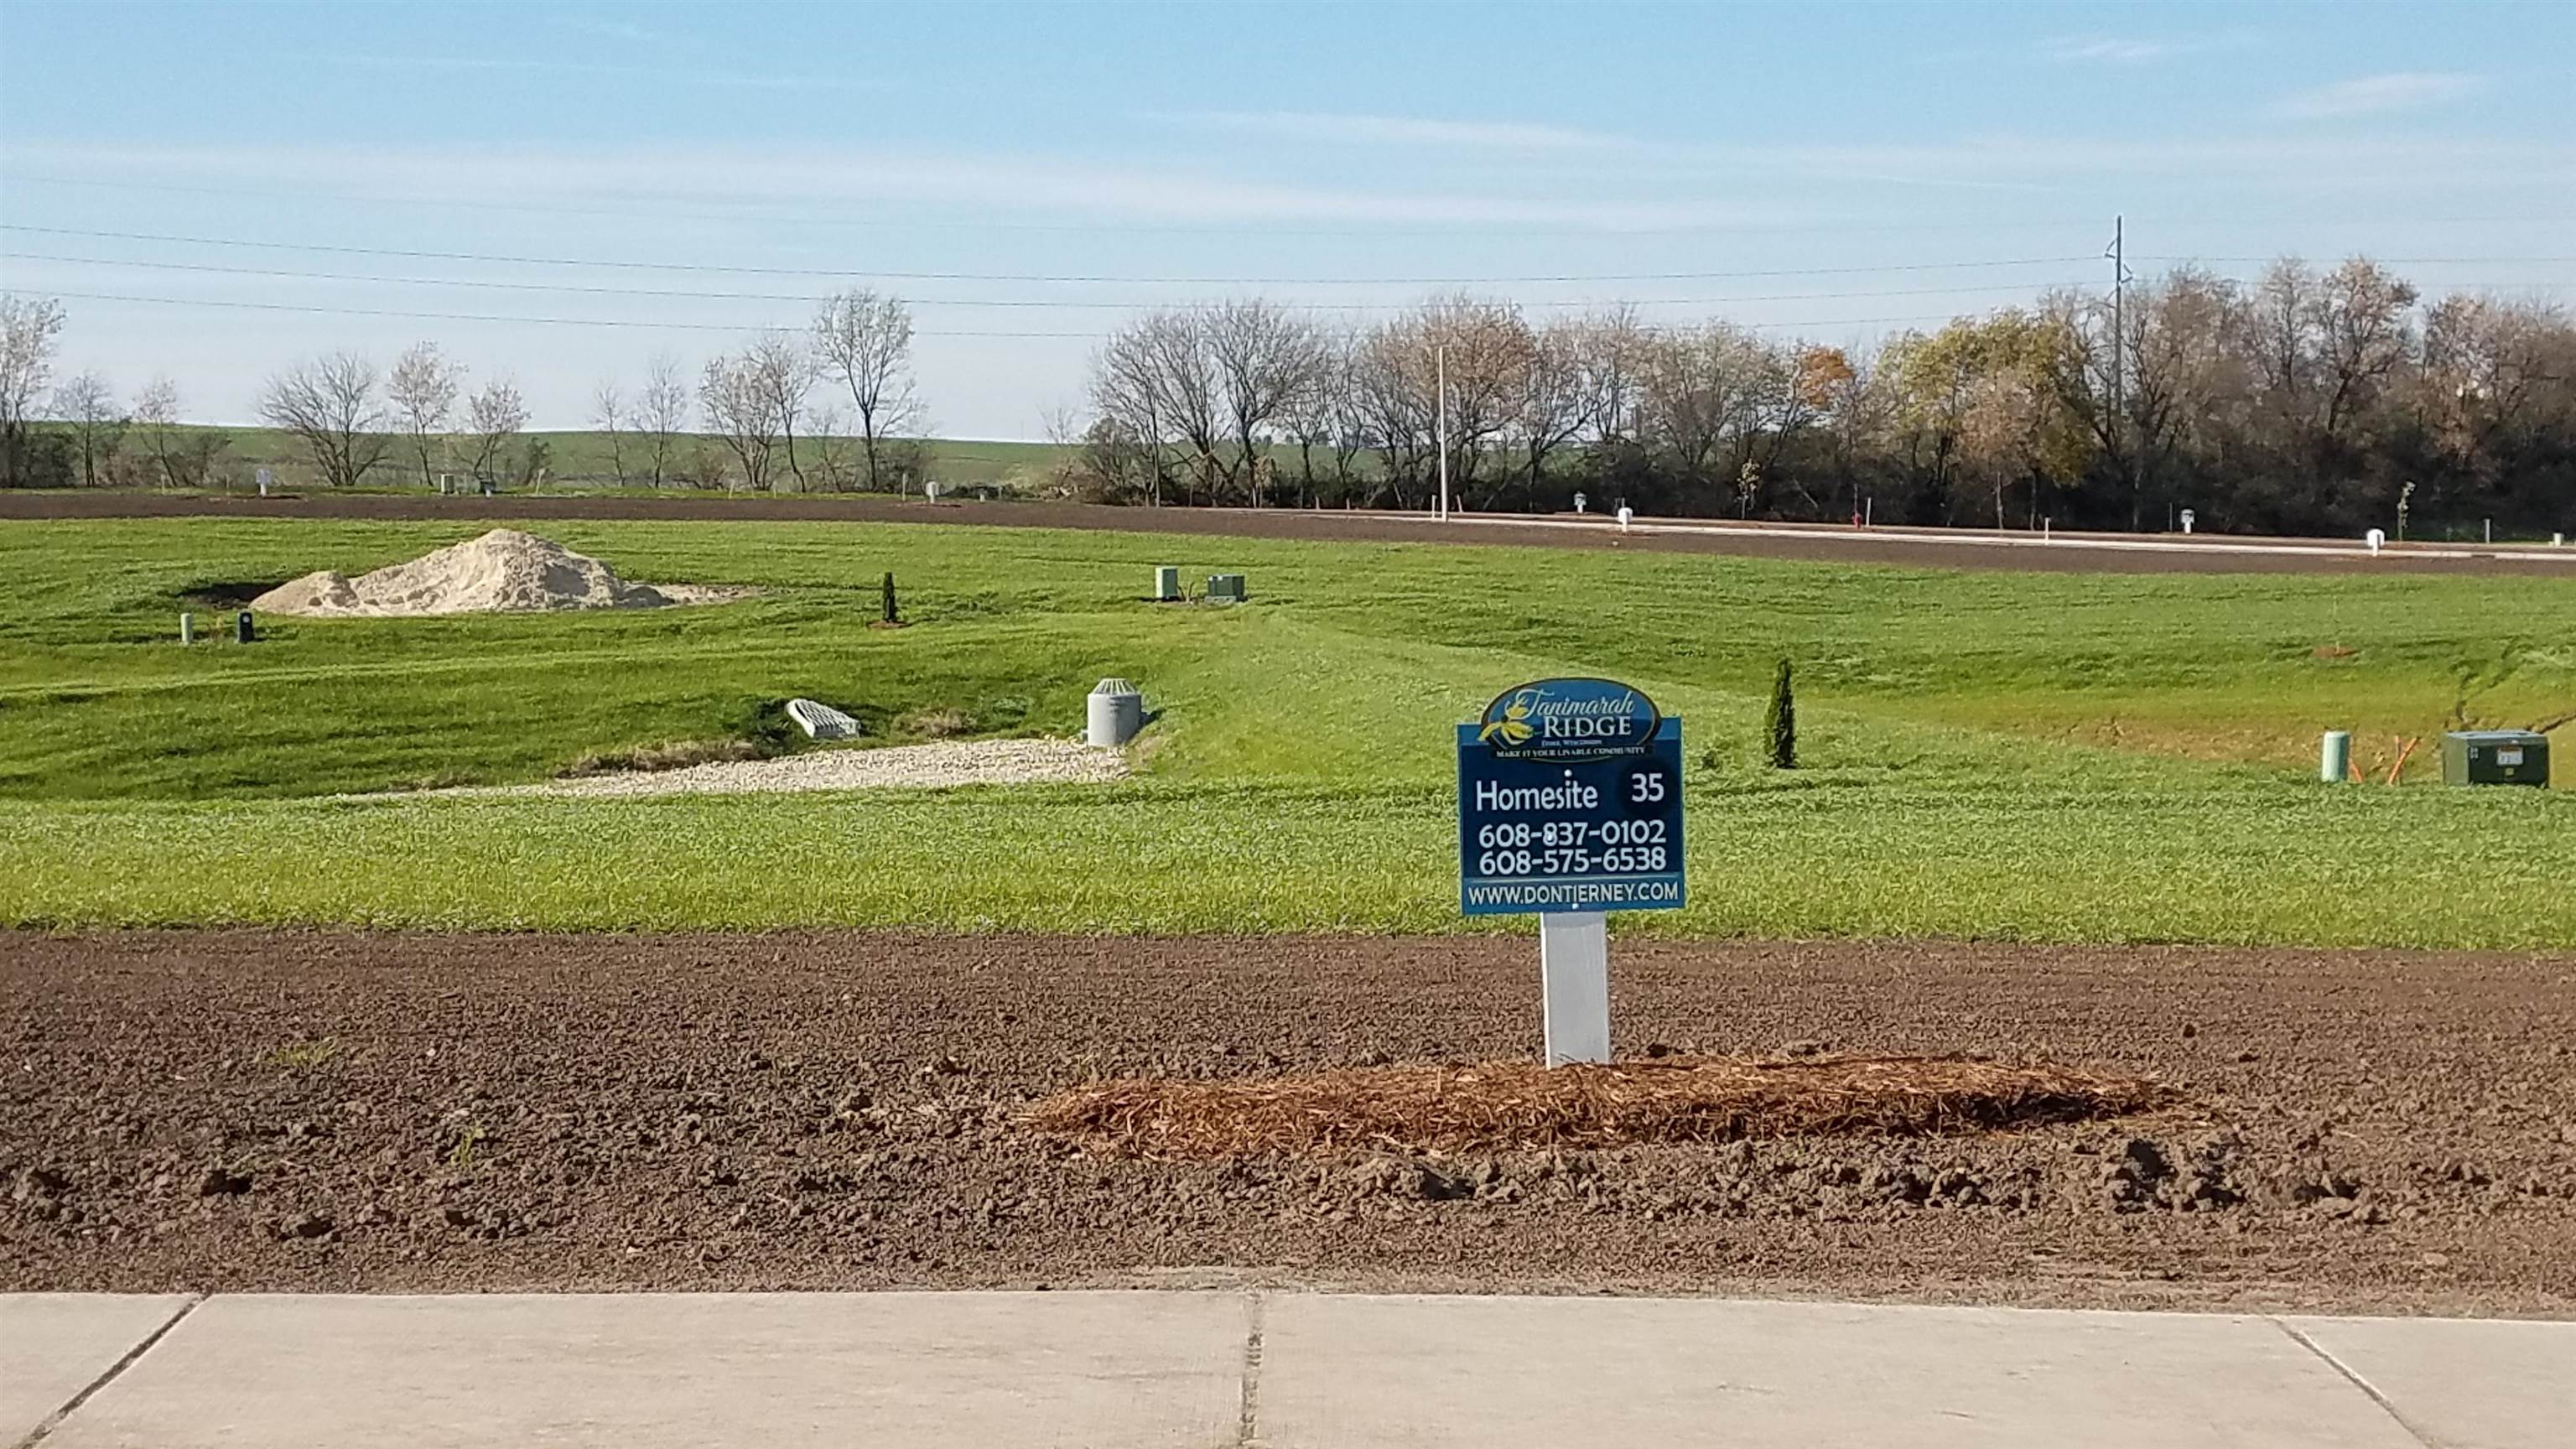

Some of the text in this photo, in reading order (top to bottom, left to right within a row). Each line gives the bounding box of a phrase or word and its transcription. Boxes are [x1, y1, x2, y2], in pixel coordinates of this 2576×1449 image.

[1505, 688, 1634, 719] Tanimarah
[1543, 715, 1632, 738] RIDGE
[1522, 749, 1531, 758] IT
[1532, 748, 1556, 757] YOUR
[1592, 745, 1645, 755] COMMUNITY
[1476, 772, 1665, 812] Homesite 35
[1478, 818, 1667, 849] 608-837-0102
[1478, 845, 1667, 875] 608-575-6538
[1468, 880, 1679, 906] WWW.DONTIERNEY.COM
